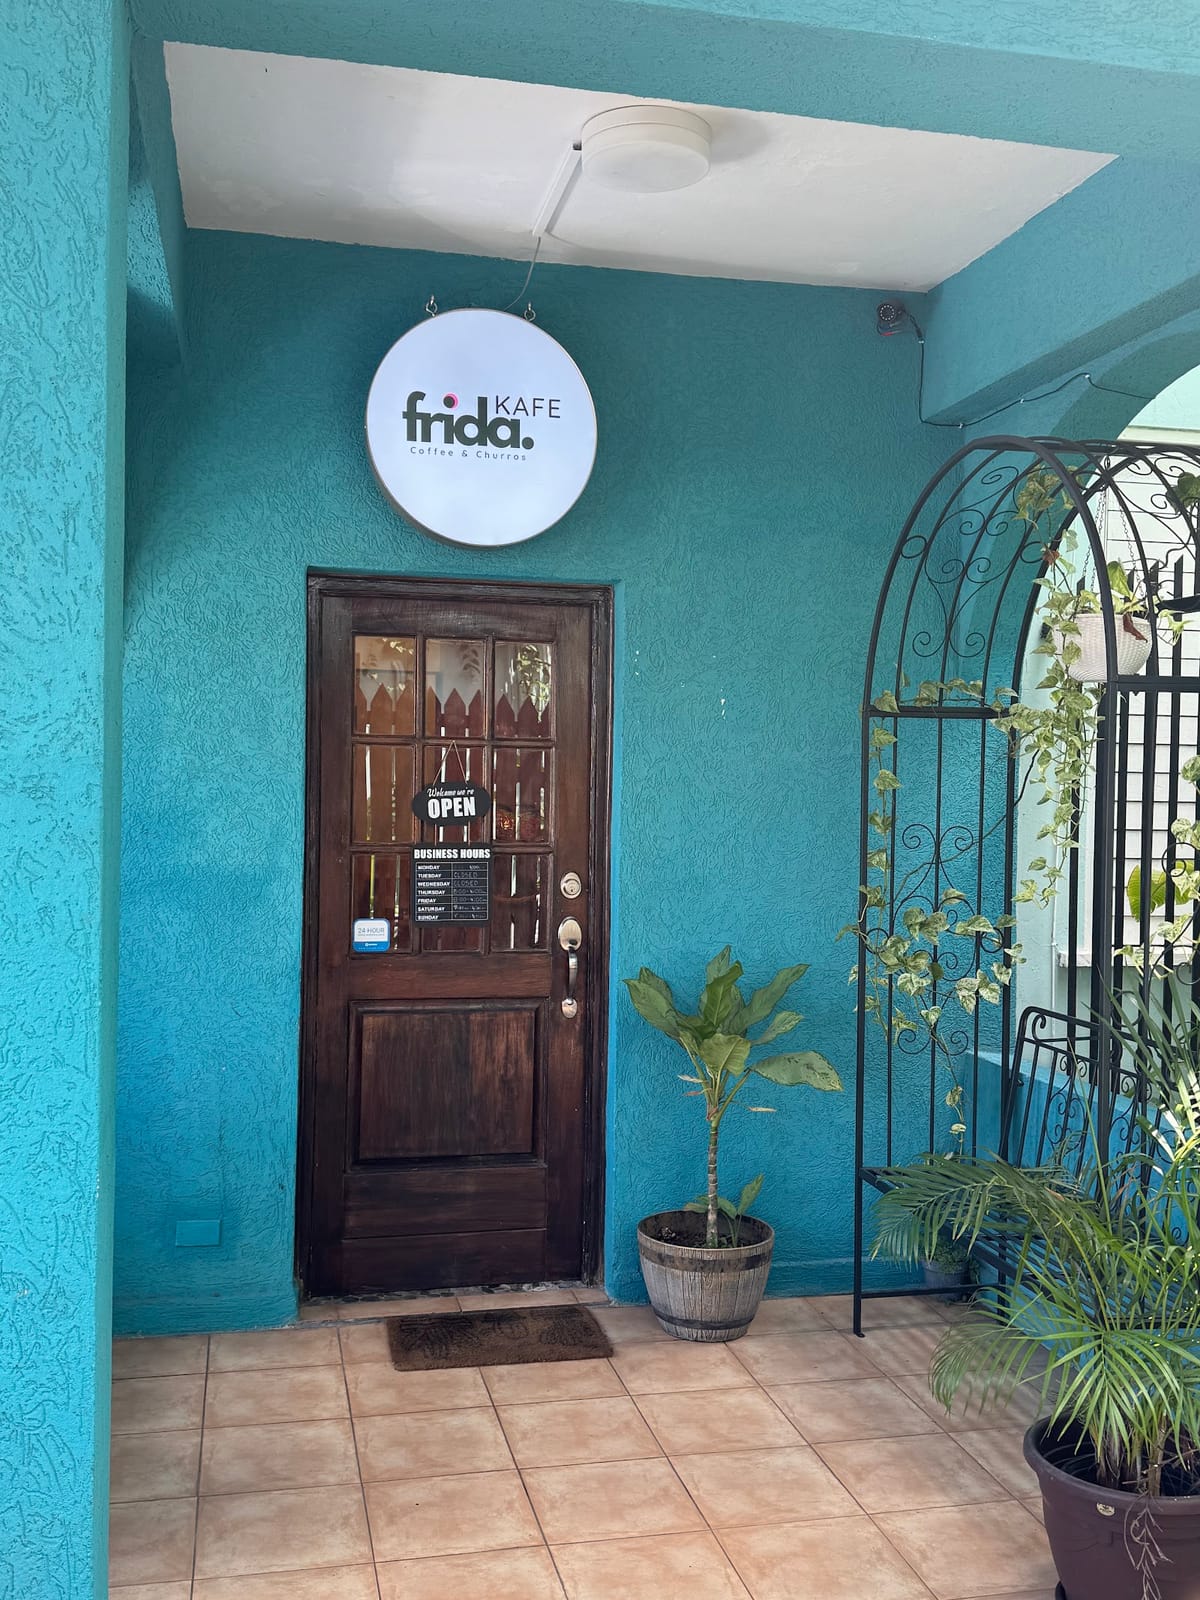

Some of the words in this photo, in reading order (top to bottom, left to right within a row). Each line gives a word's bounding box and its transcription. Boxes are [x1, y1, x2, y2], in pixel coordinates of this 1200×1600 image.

[495, 395, 561, 418] KAFE
[410, 446, 453, 456] Coffee
[476, 451, 526, 461] Churros
[427, 787, 456, 797] Welcome
[428, 797, 476, 818] OPEN
[414, 849, 458, 858] BUSINESS
[460, 849, 490, 858] HOURS
